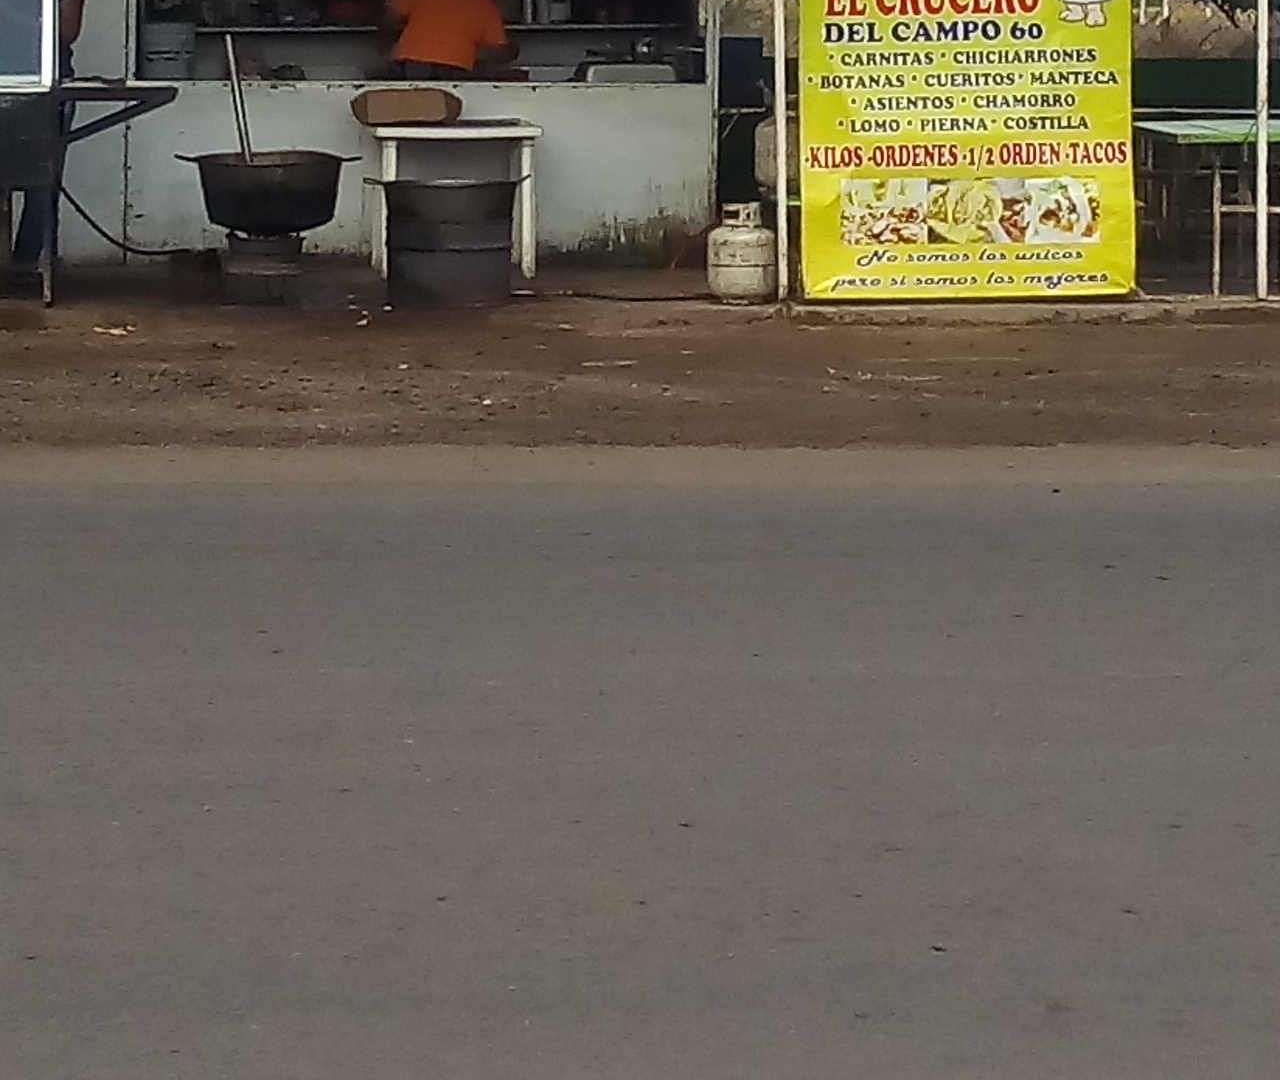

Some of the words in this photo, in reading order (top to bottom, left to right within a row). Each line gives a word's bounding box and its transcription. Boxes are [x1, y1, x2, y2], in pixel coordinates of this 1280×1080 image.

[824, 23, 883, 43] DEL
[892, 21, 1001, 42] CAMPO
[1010, 24, 1043, 40] 60
[840, 52, 934, 67] CARNITAS
[953, 49, 1097, 64] CHICHARRONES
[820, 75, 905, 89] BOTANAS
[924, 73, 1015, 87] CUERITOS
[1030, 71, 1119, 85] MANTECA
[863, 96, 954, 111] ASIENTOS
[973, 94, 1076, 108] CHAMORRO
[850, 119, 900, 133] LOMO
[920, 118, 988, 132] PIERNA
[1003, 116, 1090, 130] COSTILLA
[999, 143, 1061, 165] ORDEN
[857, 250, 898, 266] No
[906, 253, 969, 262] somos
[978, 248, 1006, 261] los
[831, 278, 880, 291] pero
[889, 275, 907, 286] si
[913, 275, 977, 285] somos
[986, 271, 1015, 285] los
[1023, 272, 1108, 289] mejores
